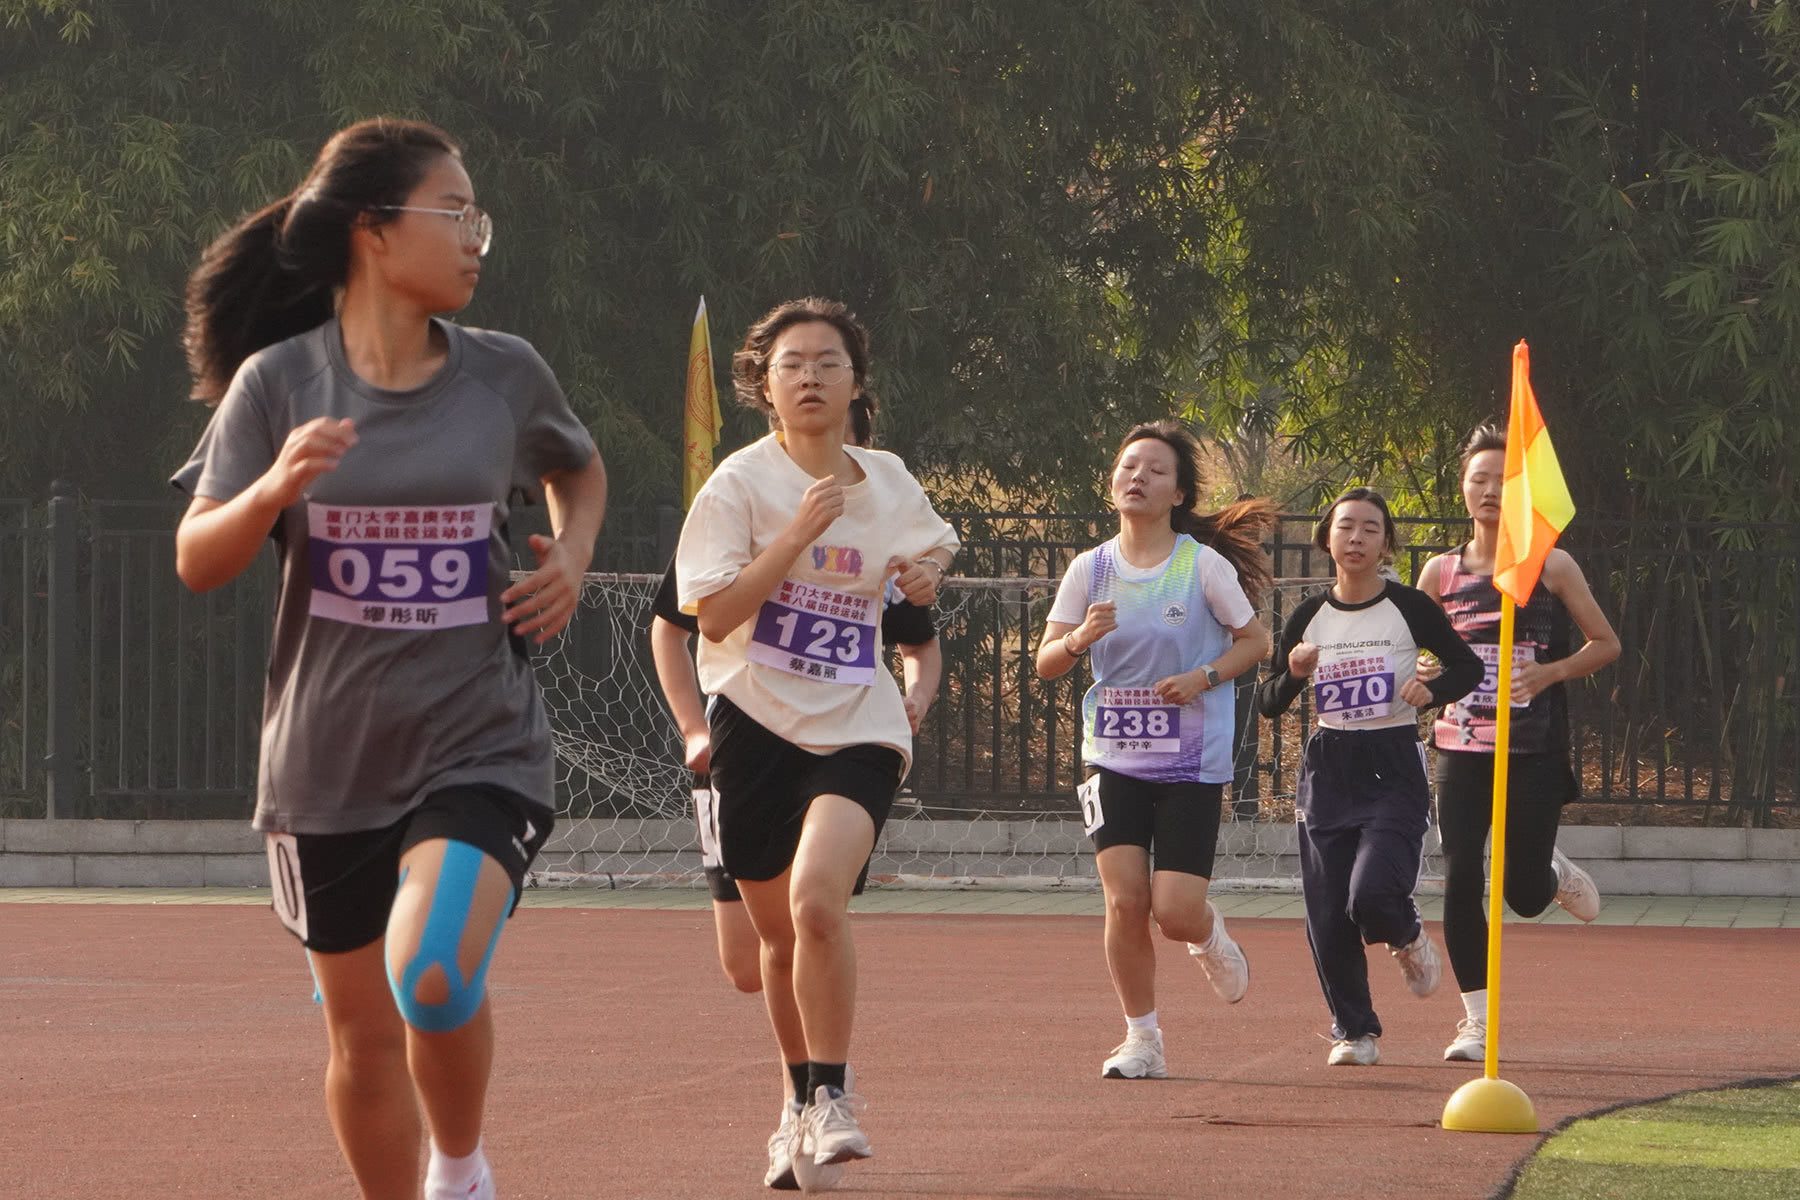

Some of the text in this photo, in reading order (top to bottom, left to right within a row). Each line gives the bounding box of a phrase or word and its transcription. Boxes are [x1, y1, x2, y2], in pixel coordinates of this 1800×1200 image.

[326, 510, 476, 524] 厦门大学嘉庚学院
[327, 526, 475, 539] 第八届田径运动会
[328, 548, 471, 599] 059
[778, 592, 866, 621] 第八届田径运动会
[782, 580, 869, 610] 厦门大学嘉庚学院
[776, 611, 861, 663] 123
[789, 657, 838, 680] 蔡嘉丽
[1322, 676, 1387, 711] 270
[1103, 709, 1170, 737] 238
